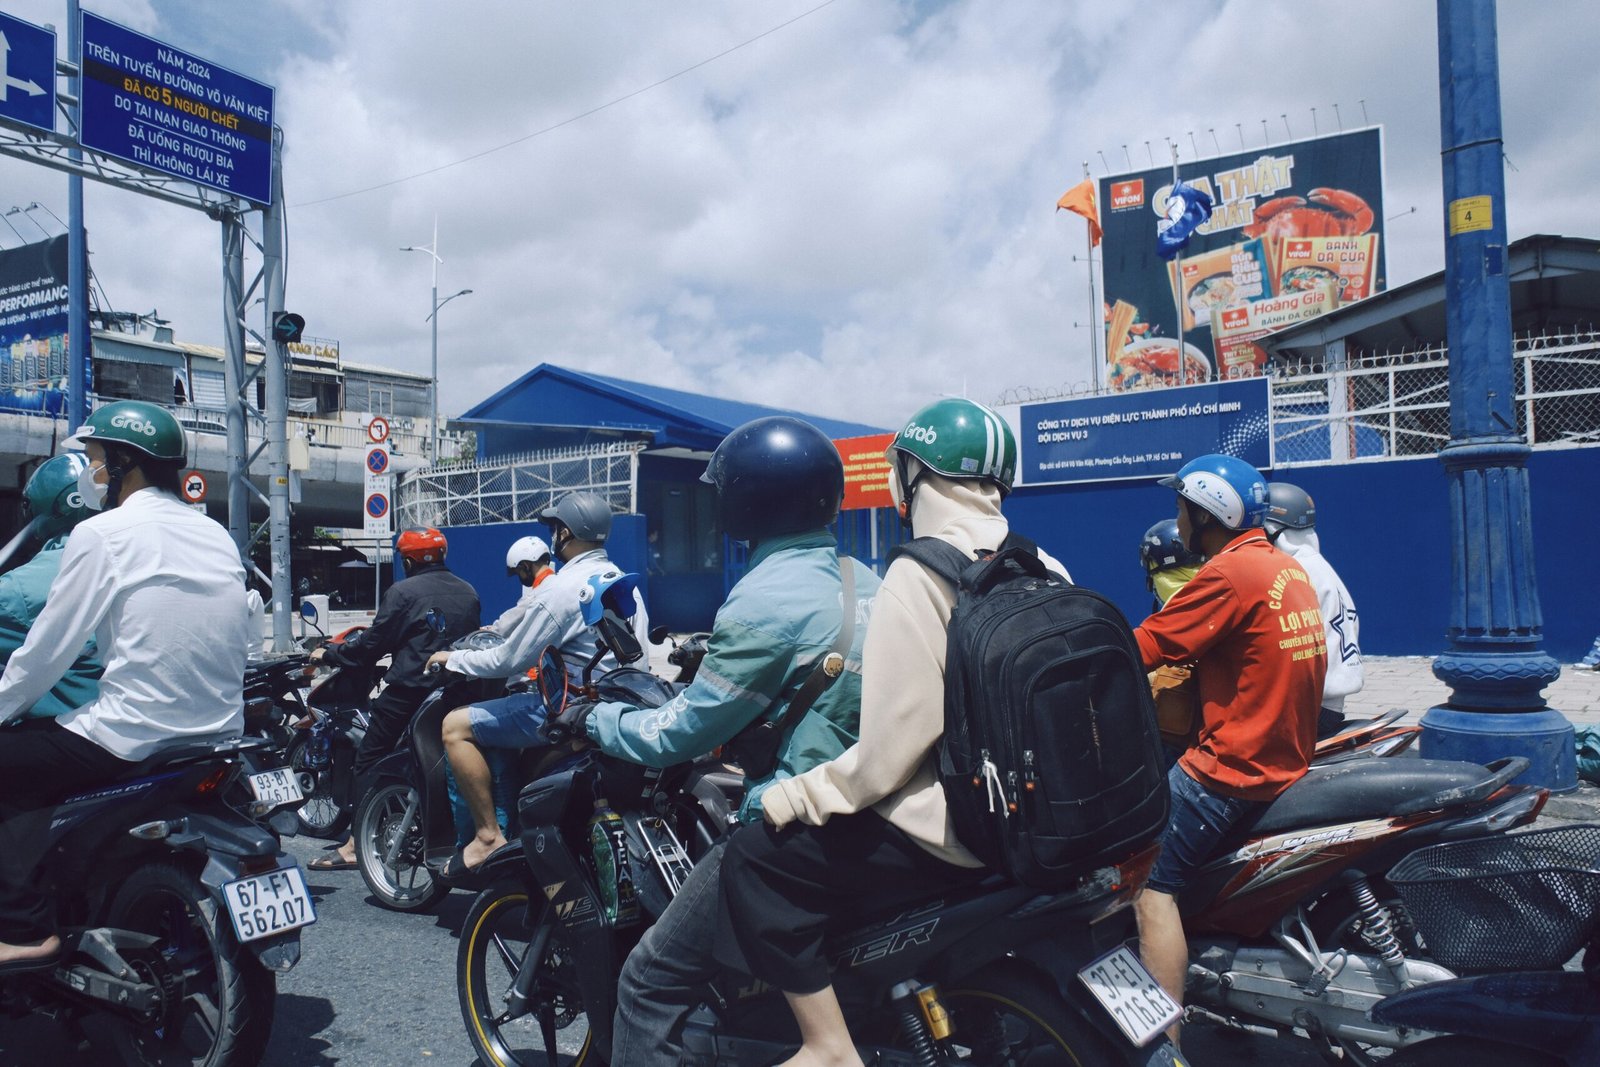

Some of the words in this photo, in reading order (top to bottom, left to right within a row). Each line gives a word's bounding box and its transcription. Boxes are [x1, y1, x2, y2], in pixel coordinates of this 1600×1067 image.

[157, 48, 184, 70] NĂM
[186, 61, 211, 80] 2024
[86, 41, 120, 66] TRÊN
[122, 55, 161, 81] TUYẾN
[164, 72, 204, 97] ĐƯỜNG
[206, 87, 221, 103] VÕ
[223, 94, 245, 113] VĂN
[247, 104, 270, 122] KIỆT
[124, 78, 142, 95] ĐÃ
[144, 85, 160, 102] CÓ
[162, 87, 172, 106] 5
[174, 97, 209, 120] NGƯỜI
[211, 110, 240, 130] CHẾT
[114, 94, 131, 111] DO
[134, 101, 152, 119] TAI
[154, 108, 180, 128] NẠN
[182, 119, 208, 138] GIAO
[210, 128, 246, 151] THÔNG
[128, 124, 145, 141] ĐÃ
[148, 130, 180, 152] UỐNG
[183, 143, 213, 163] RƯỢU
[216, 153, 234, 171] BIA
[132, 145, 151, 162] THÌ
[154, 152, 194, 176] KHÔNG
[196, 166, 214, 183] LÁI
[216, 172, 231, 188] XE
[1215, 155, 1295, 198] THẬT
[1114, 194, 1141, 205] VIFON
[1465, 210, 1472, 222] 4
[1340, 252, 1366, 262] CUA
[0, 285, 69, 313] PERFORMANC
[1254, 297, 1299, 316] Hoàng
[111, 415, 157, 436] Grab
[1037, 419, 1059, 430] CÔNG
[1061, 420, 1070, 428] TY
[1071, 418, 1089, 429] DỊCH
[1090, 416, 1101, 426] VỤ
[1102, 413, 1121, 425] ĐIỆN
[1122, 412, 1140, 423] LỰC
[1141, 408, 1168, 420] THÀNH
[1170, 403, 1187, 417] PHỐ
[1203, 402, 1218, 414] CHÍ
[1219, 401, 1241, 412] MINH
[904, 422, 937, 445] Grab
[1037, 431, 1051, 443] ĐỘI
[1052, 431, 1070, 443] DỊCH
[1071, 431, 1082, 441] VỤ
[1083, 430, 1088, 439] 3
[1267, 575, 1287, 610] CÔNG
[1279, 611, 1302, 634] LỢI
[257, 771, 289, 791] 93-B1
[236, 872, 294, 908] 67-F1
[239, 896, 307, 938] 562.07
[1090, 953, 1143, 1000] 37-E1
[1114, 983, 1175, 1040] 716.63
